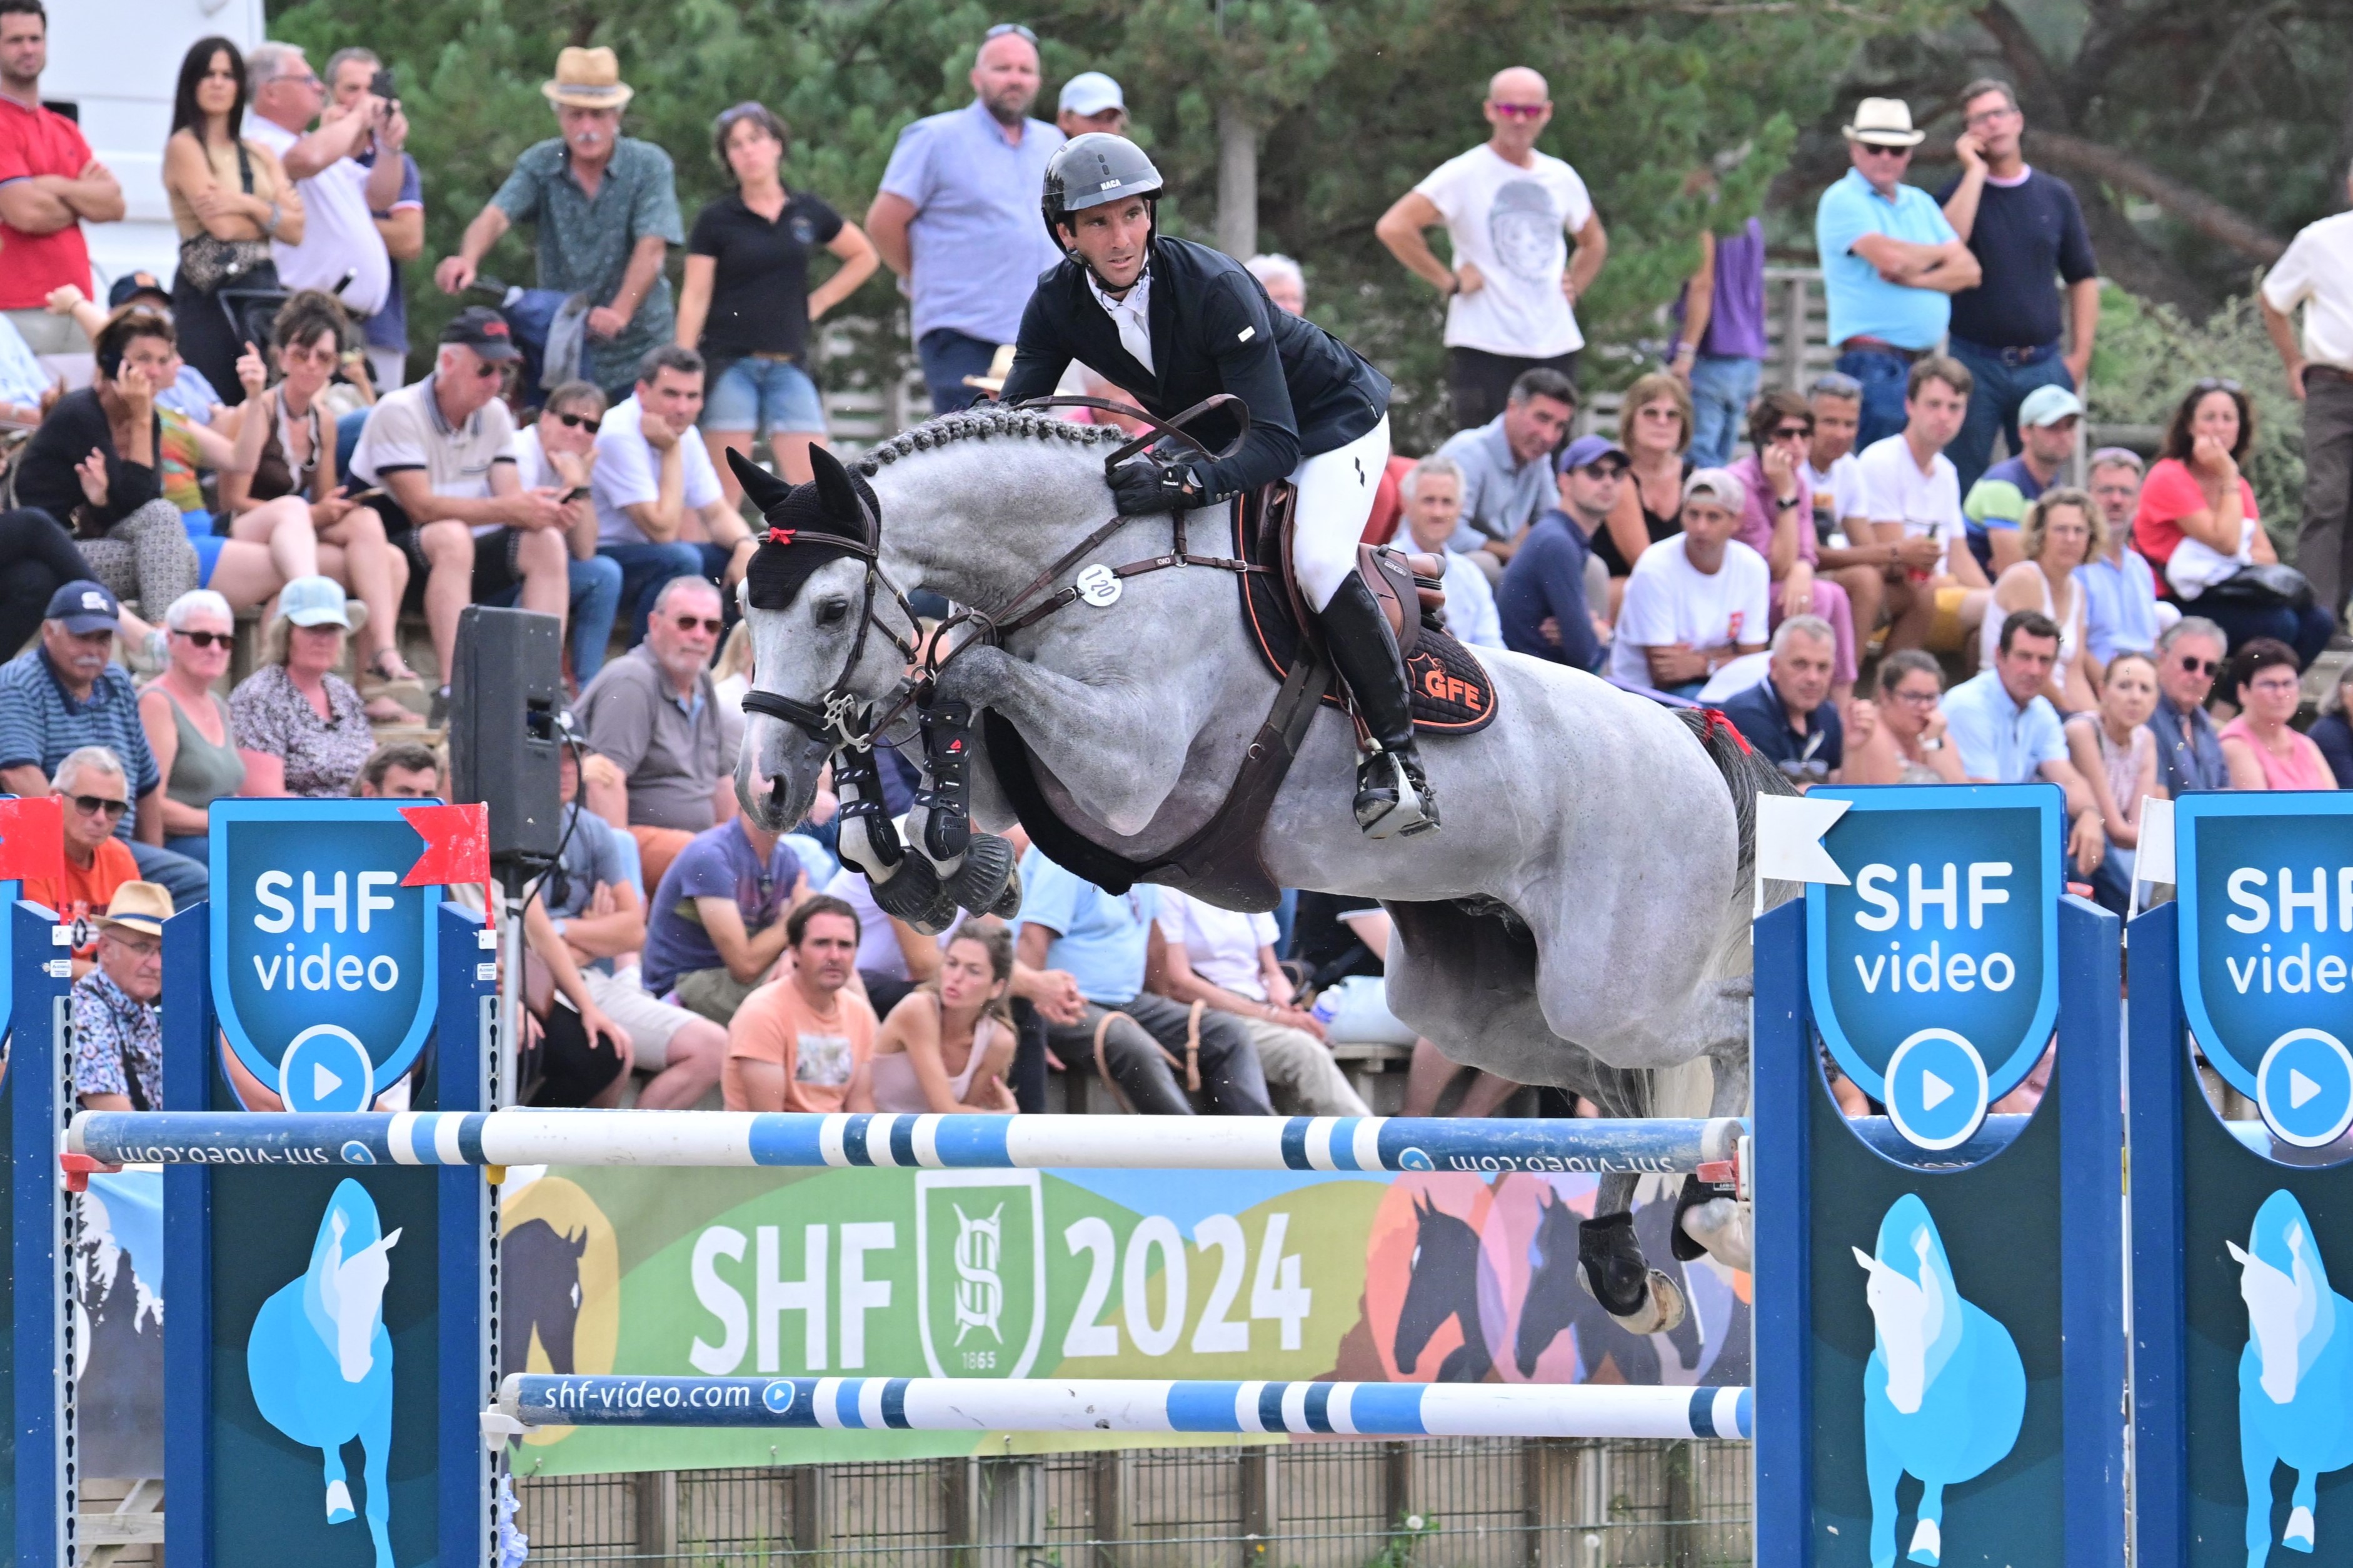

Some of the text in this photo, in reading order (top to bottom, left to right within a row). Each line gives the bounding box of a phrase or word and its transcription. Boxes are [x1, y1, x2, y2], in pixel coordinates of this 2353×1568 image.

[1085, 569, 1116, 597] 120
[1425, 669, 1482, 711] GFE
[254, 870, 398, 934] SHF
[1855, 862, 2013, 932] SHF
[253, 942, 399, 992] video
[1854, 940, 2015, 993] video
[2226, 942, 2353, 994] vide
[689, 1212, 1312, 1376] SHF 2024
[962, 1351, 996, 1369] 1865
[544, 1380, 750, 1409] shf-video.com
